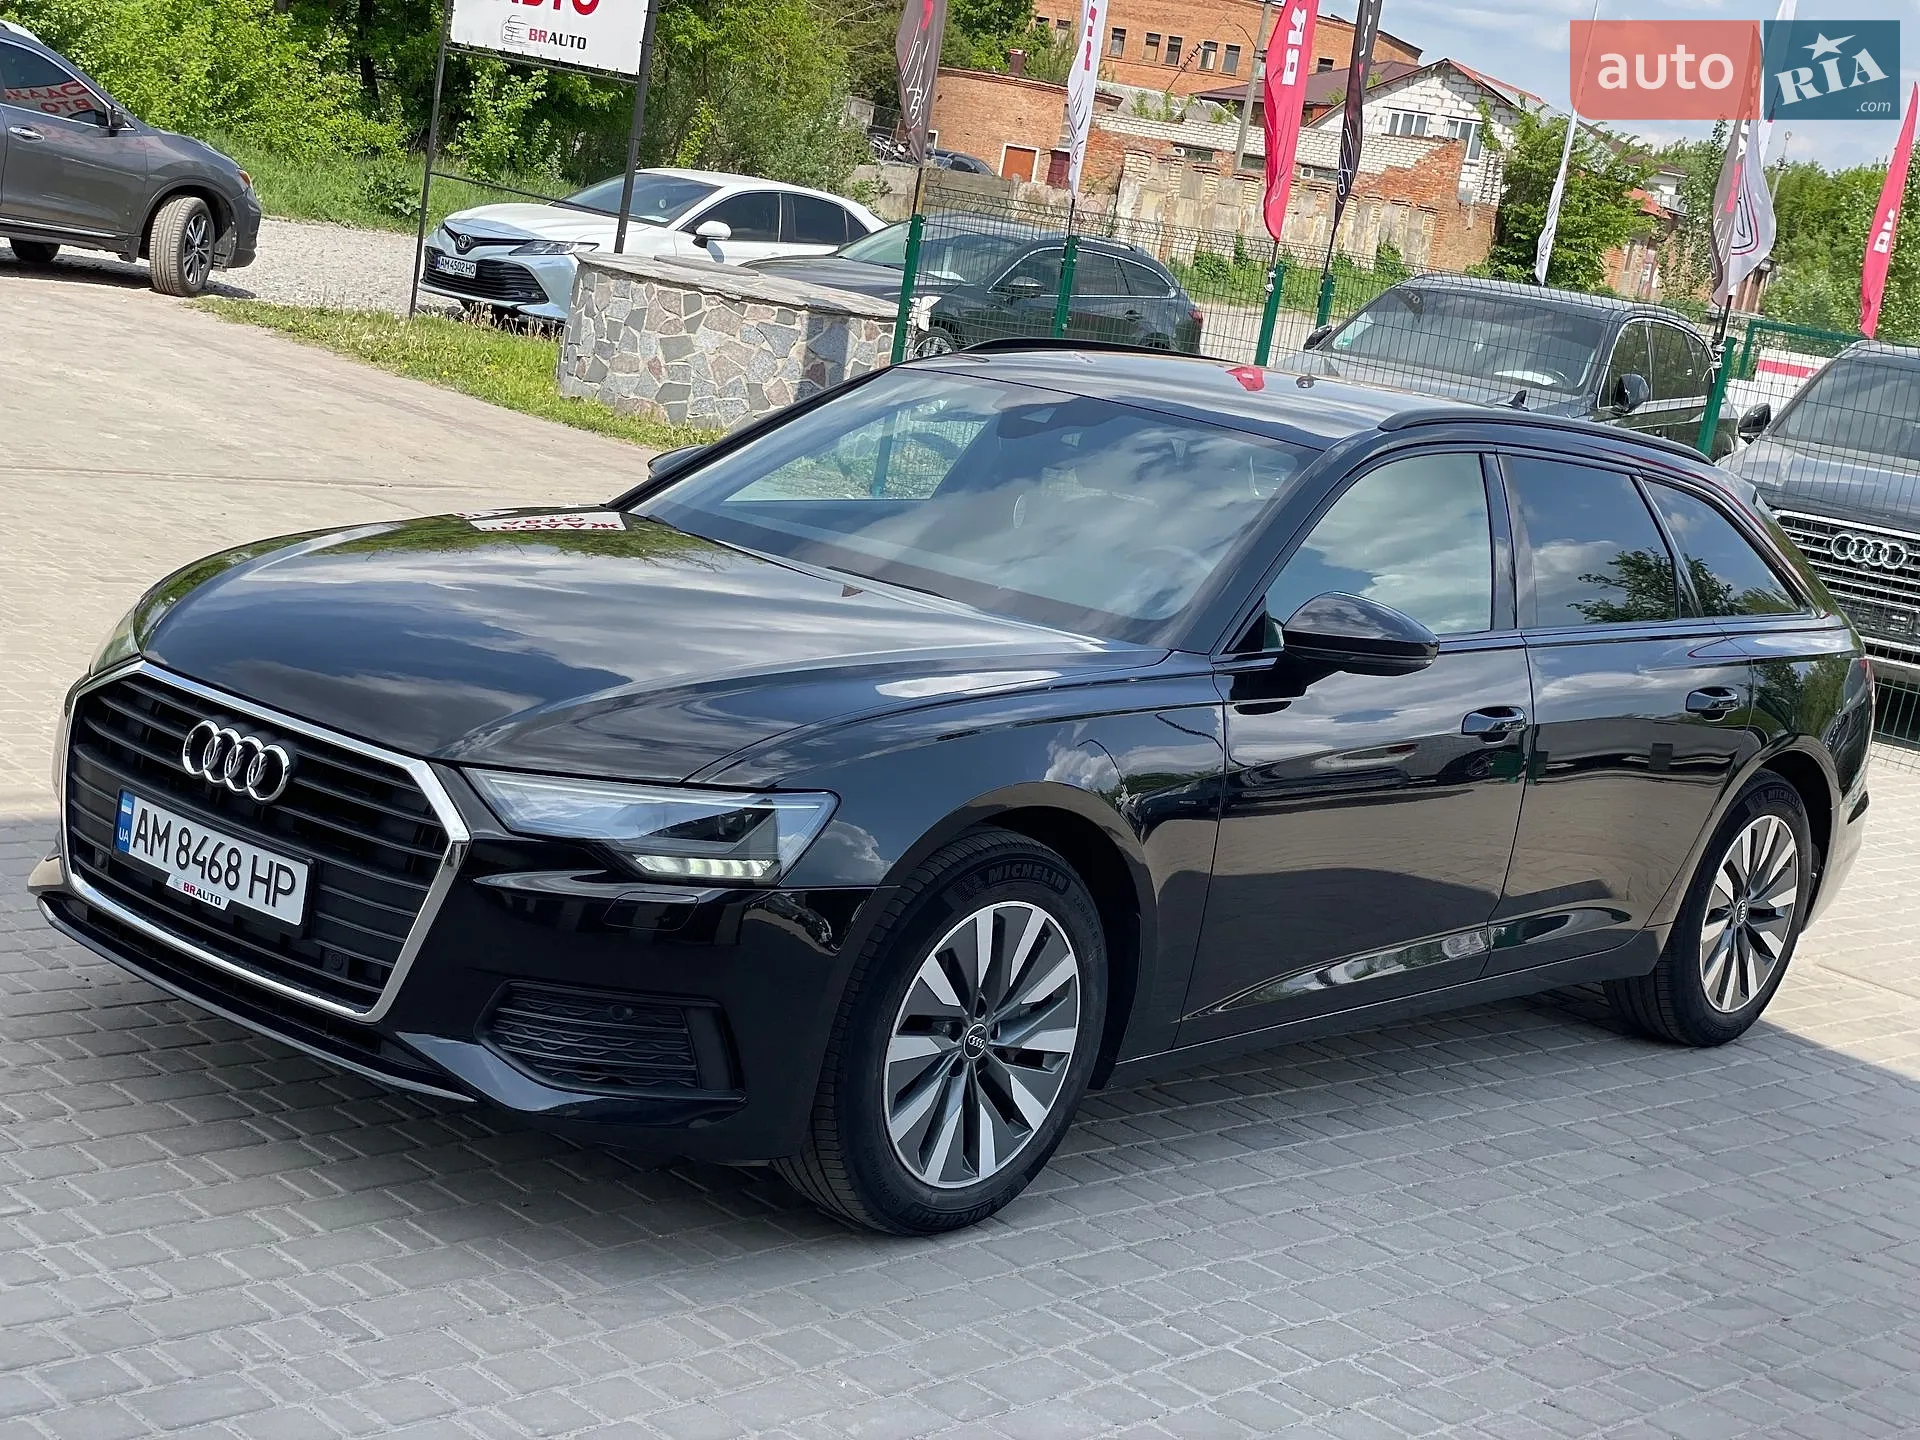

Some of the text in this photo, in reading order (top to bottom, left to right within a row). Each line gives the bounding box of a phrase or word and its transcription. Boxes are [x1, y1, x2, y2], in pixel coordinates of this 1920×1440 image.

[528, 27, 587, 50] BRAUTO
[118, 827, 130, 844] UA
[132, 807, 297, 909] AM 8468 HP
[987, 863, 1067, 890] MICHELIN
[182, 881, 223, 906] BRAUTO
